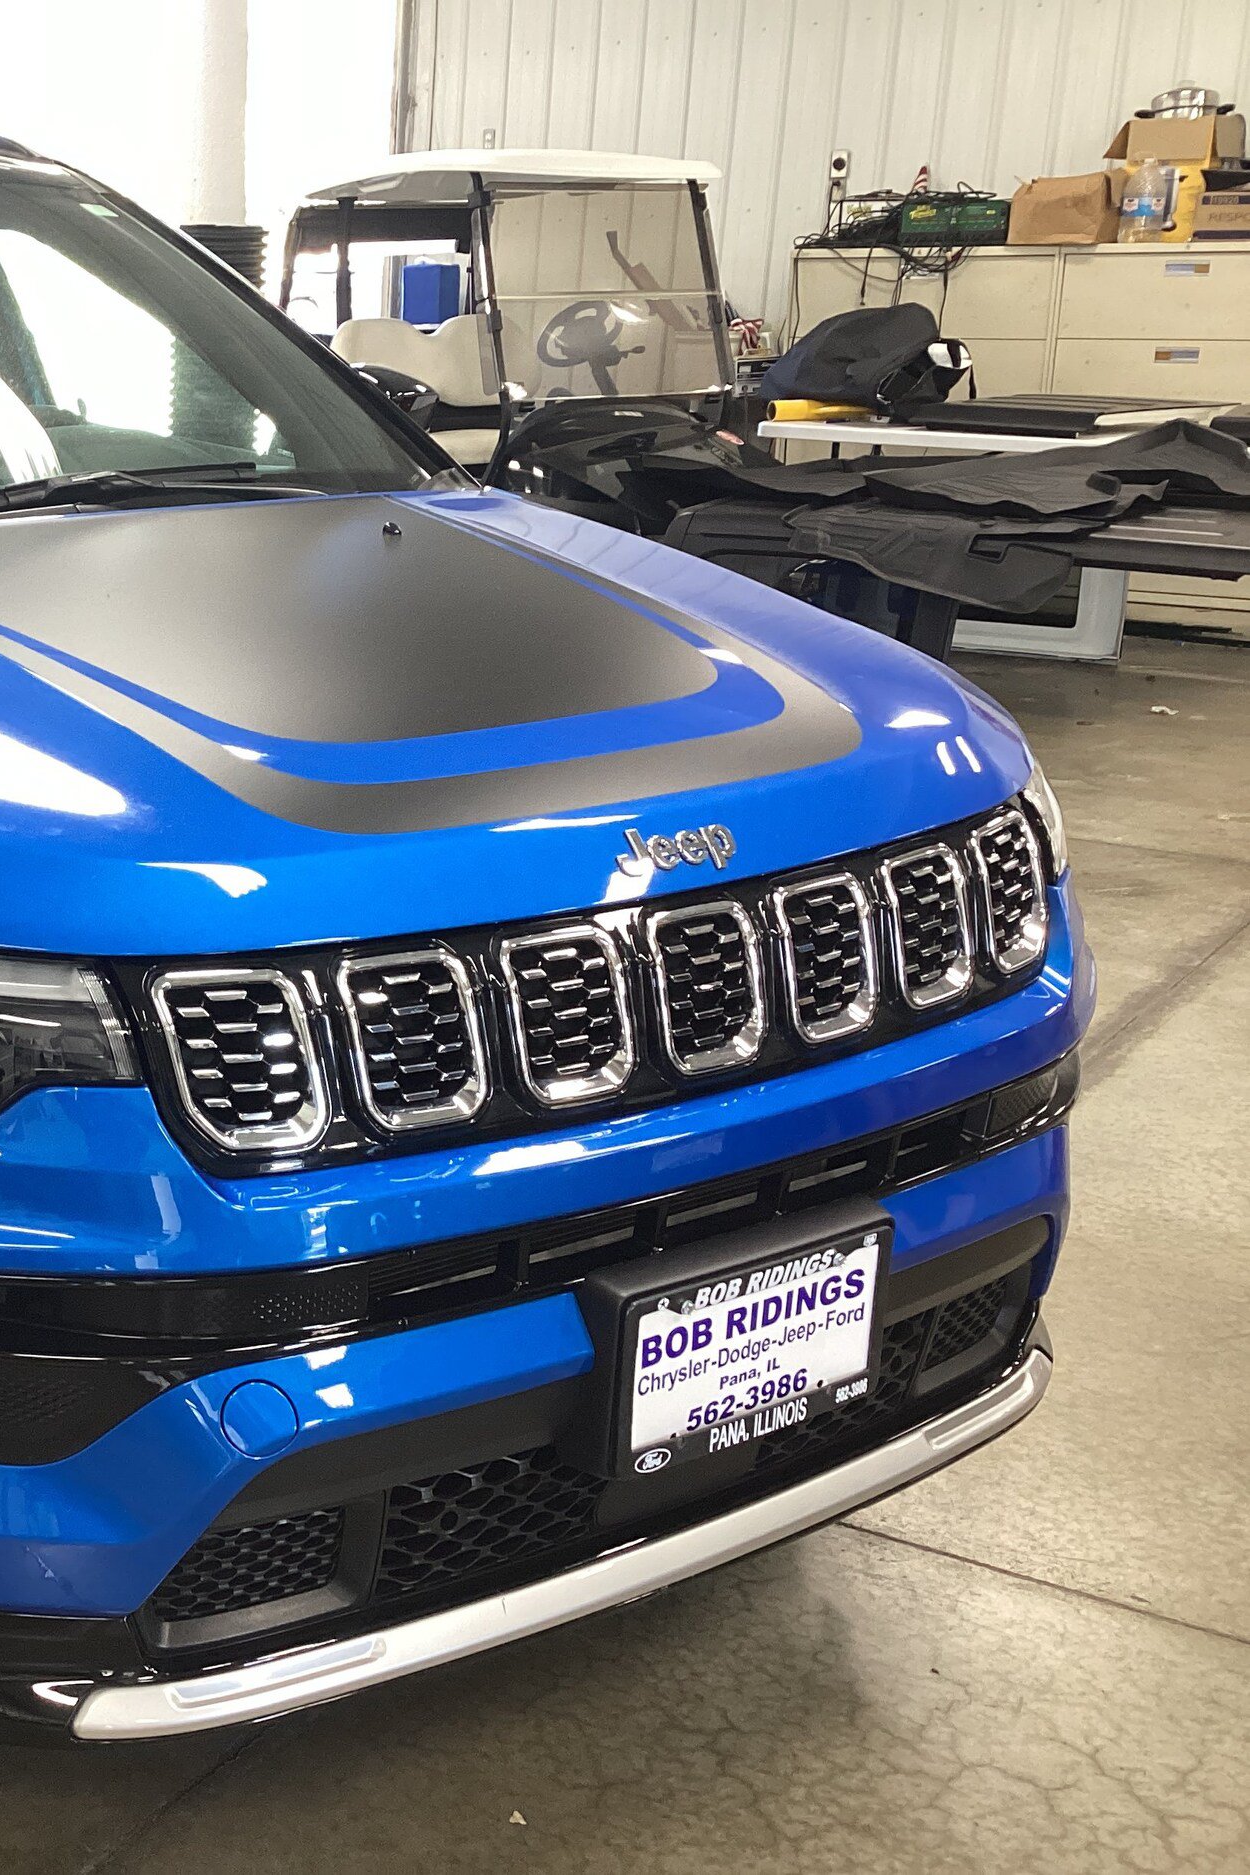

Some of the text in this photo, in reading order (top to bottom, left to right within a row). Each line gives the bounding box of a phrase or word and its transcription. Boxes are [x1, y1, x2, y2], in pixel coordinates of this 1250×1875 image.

[616, 824, 735, 877] Jeep
[694, 1249, 836, 1308] BOB RIDINGS
[641, 1269, 865, 1369] BOB RIDINGS
[638, 1302, 865, 1396] Chrysler-Dodge-Jeep-Ford
[719, 1357, 780, 1390] Pana, IL
[686, 1368, 808, 1431] 562-3986
[753, 1397, 807, 1438] ILLINOIS
